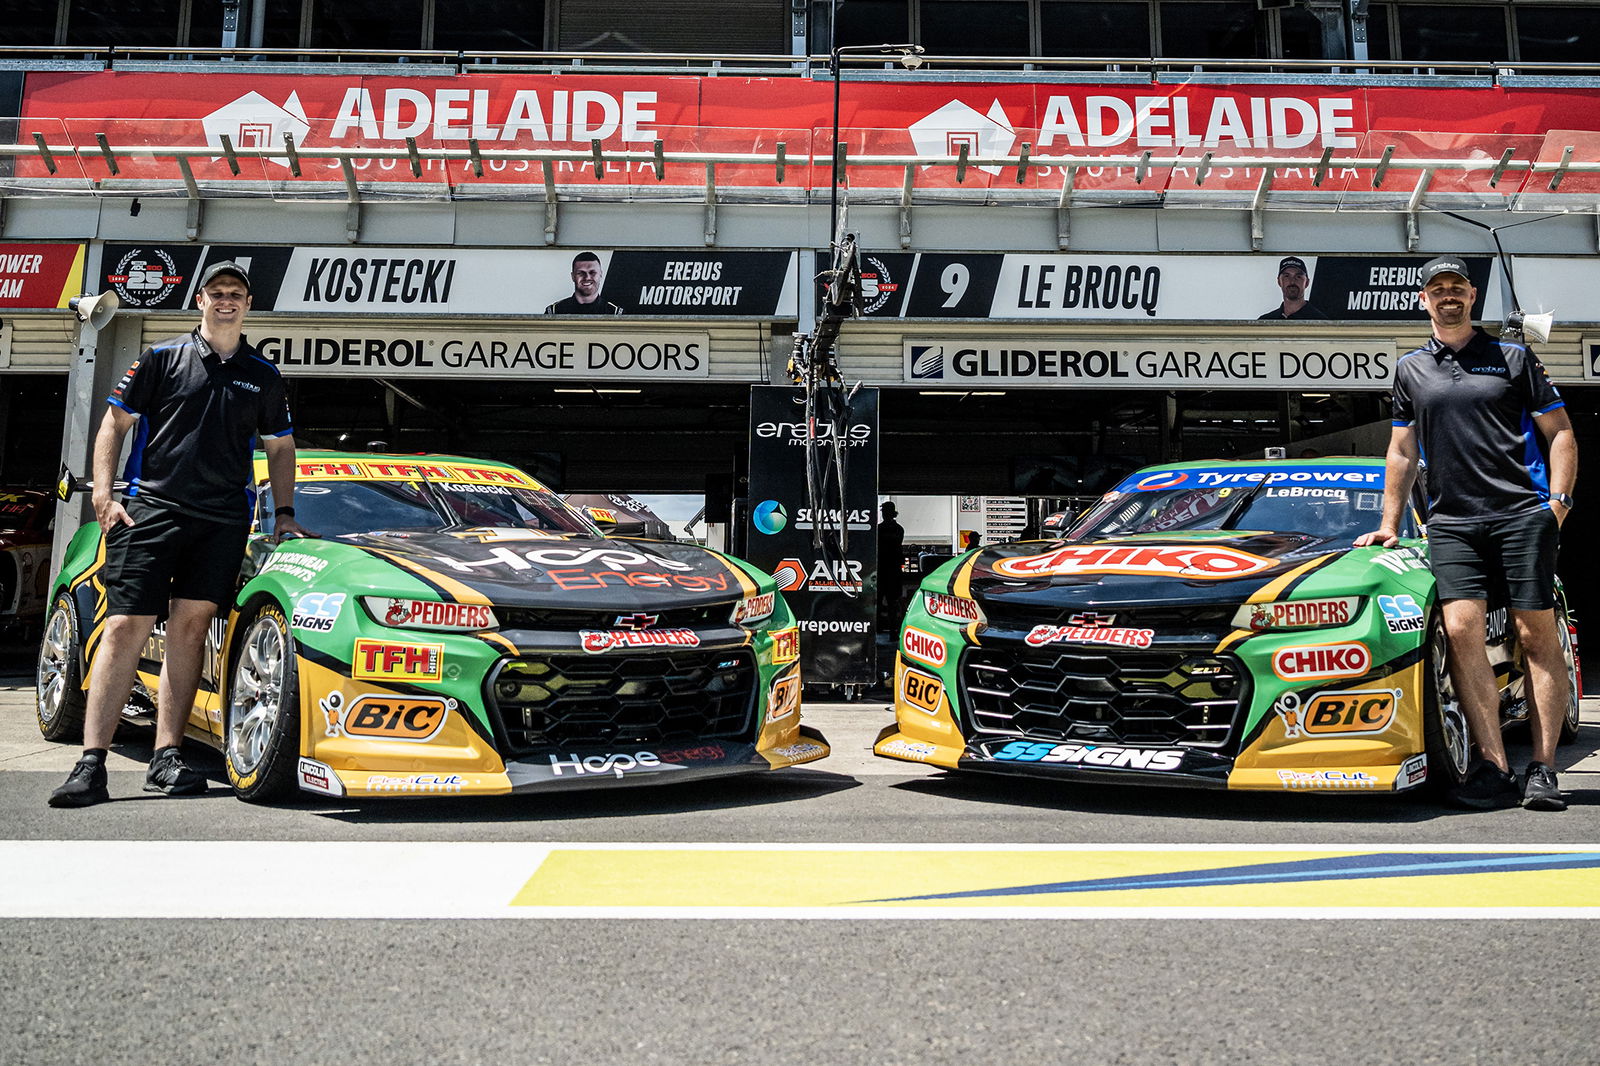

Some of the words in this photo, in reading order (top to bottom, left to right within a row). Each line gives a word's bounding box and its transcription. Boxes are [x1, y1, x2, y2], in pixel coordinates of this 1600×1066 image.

[330, 87, 658, 142] ADELAIDE
[1037, 95, 1357, 149] ADELAIDE
[127, 271, 164, 289] 25
[303, 257, 457, 304] KOSTECKI
[663, 261, 723, 281] EREBUS
[638, 285, 742, 306] MOTORSPORT
[940, 262, 970, 308] 9
[1018, 264, 1055, 309] LE
[1062, 265, 1161, 316] BROCQ
[441, 341, 575, 369] GARAGE
[587, 343, 700, 371] DOORS
[952, 349, 1129, 378] GLIDEROL
[1135, 351, 1267, 379] GARAGE
[1280, 352, 1389, 380] DOORS
[369, 464, 445, 478] TFH
[454, 467, 520, 484] TFH
[1197, 470, 1381, 485] Tyrepower
[440, 482, 513, 496] Kostecki
[1218, 487, 1232, 498] 9
[1266, 487, 1349, 500] LeBrocq
[1010, 548, 1257, 573] CHIKO
[546, 568, 731, 592] Energy
[297, 593, 345, 616] SS
[410, 601, 490, 628] PEDDERS
[744, 594, 773, 618] PEDDERS
[938, 594, 978, 620] PEDDERS
[1274, 600, 1349, 627] PEDDERS
[1378, 595, 1423, 618] SS
[610, 629, 700, 648] PEDDERS
[905, 631, 944, 661] CHIKO
[1054, 626, 1153, 647] PEDDERS
[360, 644, 430, 673] TFH
[429, 648, 437, 673] HIRE
[1278, 647, 1365, 674] CHIKO
[549, 751, 661, 779] Hope
